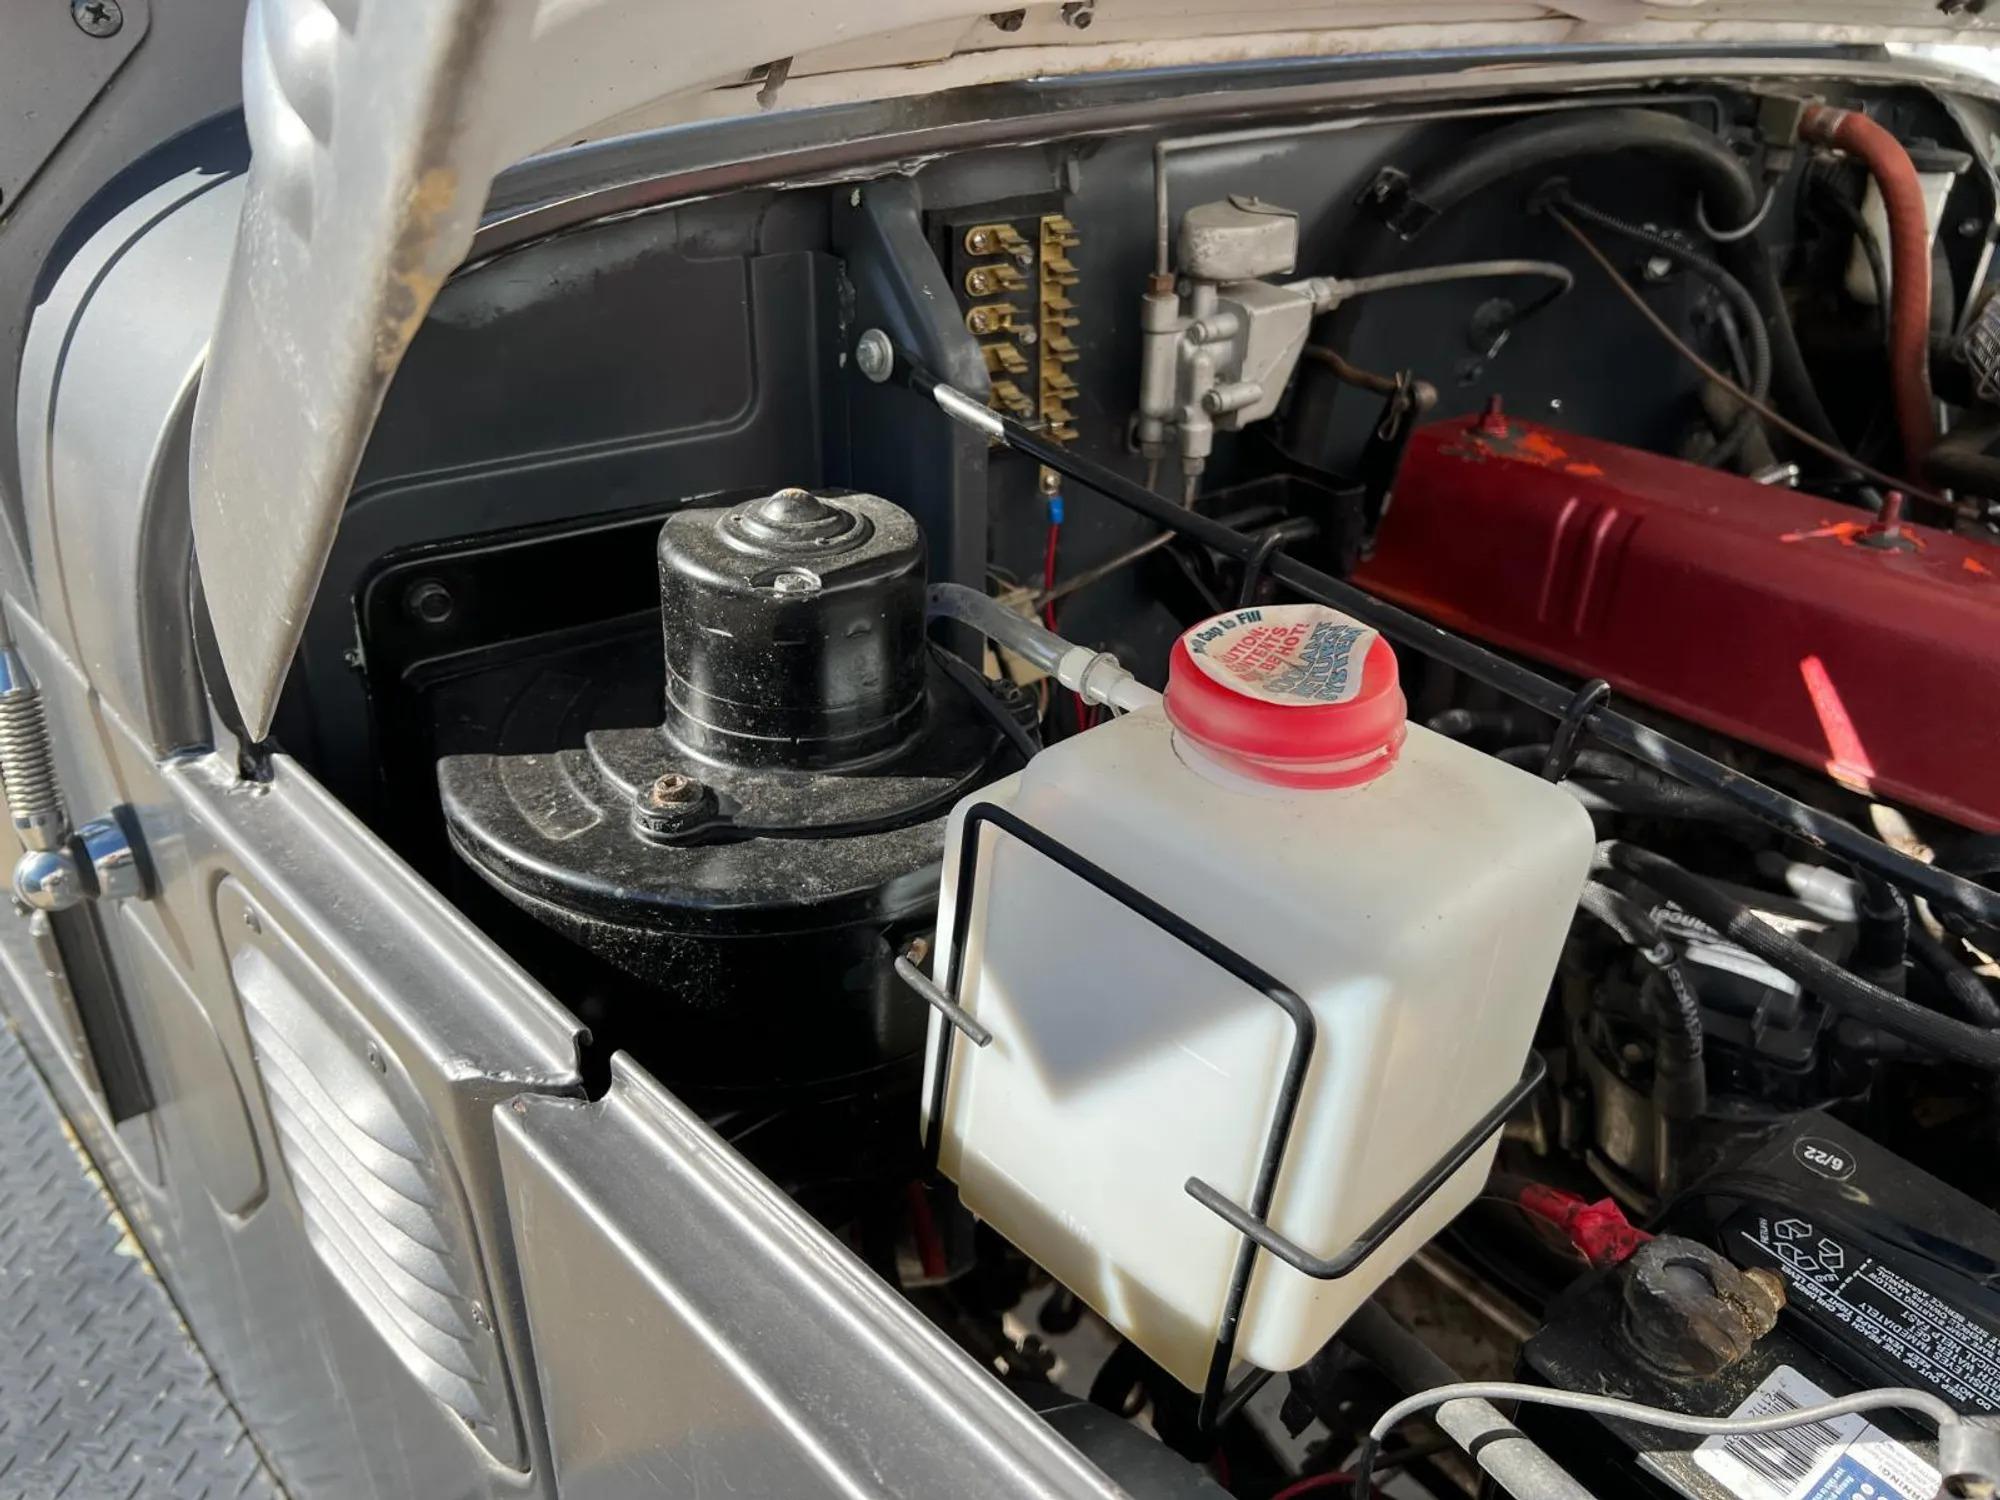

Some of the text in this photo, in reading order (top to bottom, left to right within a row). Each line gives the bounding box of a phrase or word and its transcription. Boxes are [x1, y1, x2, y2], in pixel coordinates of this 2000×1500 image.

[1237, 610, 1261, 625] Fill
[1280, 623, 1311, 660] HOT!
[1803, 1145, 1843, 1171] 6/22
[1815, 1273, 1839, 1282] LEAD
[1867, 1272, 1903, 1297] FOLLOW
[1903, 1295, 1945, 1326] STARTING
[1911, 1291, 1948, 1319] OWNERS
[1900, 1308, 1930, 1332] FAST
[1907, 1323, 1932, 1343] GET
[1779, 1263, 1992, 1411] DO NOT TIP KEEP VENT CAPS TIGHT AND LEVEL
[1791, 1279, 1966, 1402] KEEP OUT OF THE REACH OF CHILDREN
[1858, 1301, 2000, 1401] FLUSH EYES IMMEDIATELY
[1930, 1328, 1962, 1353] HELP
[1933, 1340, 1975, 1373] WATER.
[1962, 1350, 2000, 1380] EDICAL
